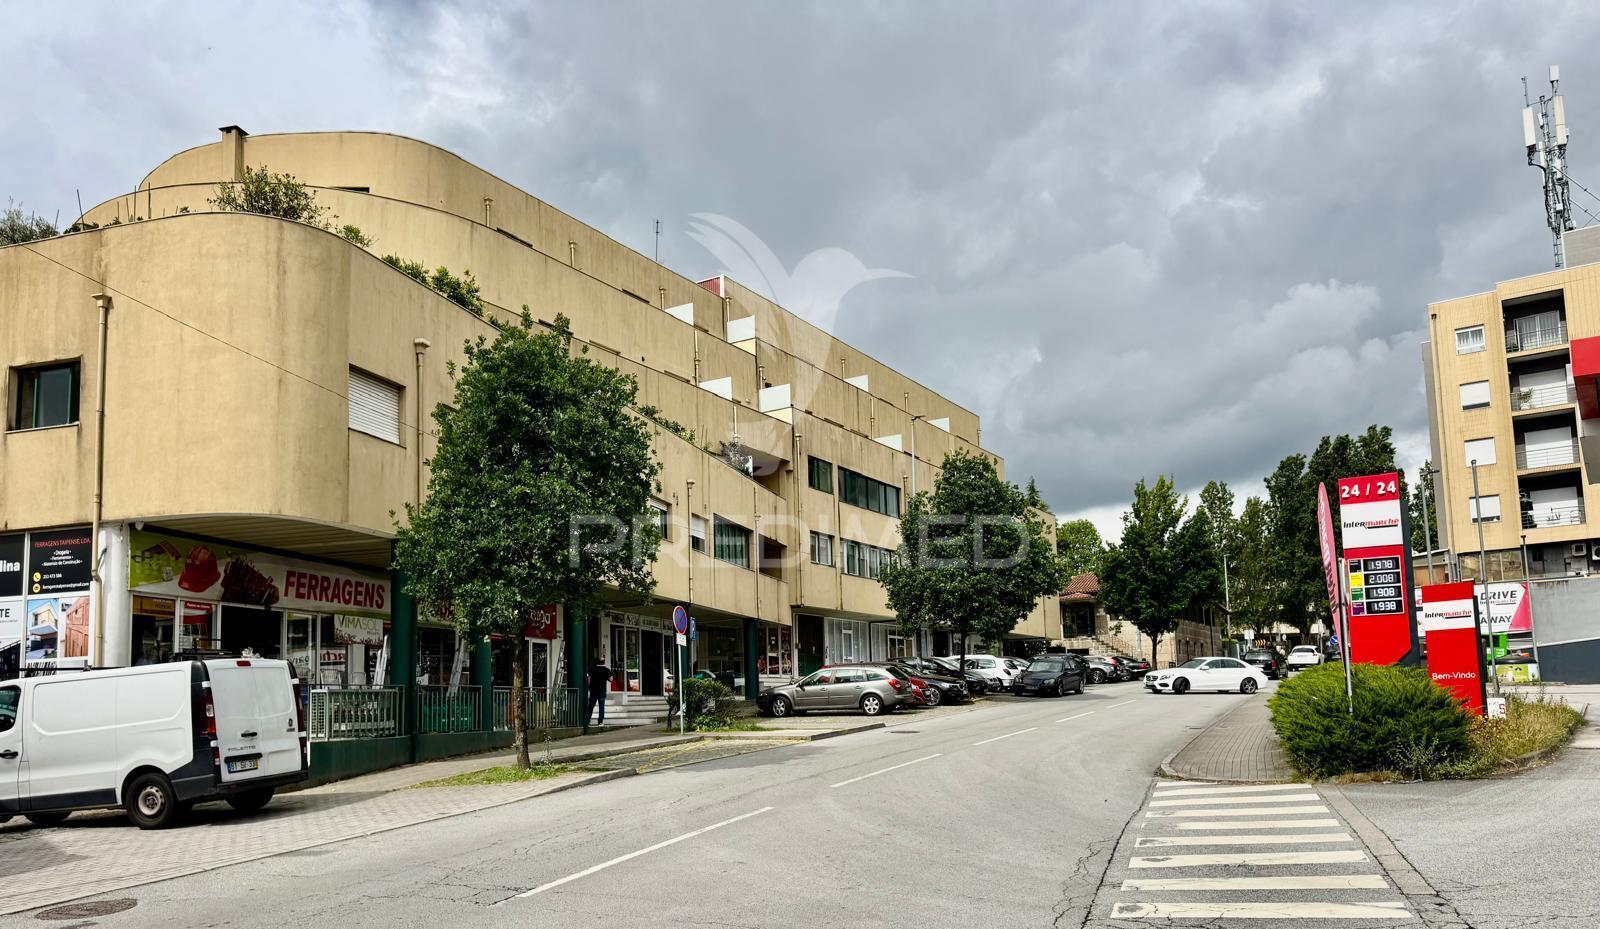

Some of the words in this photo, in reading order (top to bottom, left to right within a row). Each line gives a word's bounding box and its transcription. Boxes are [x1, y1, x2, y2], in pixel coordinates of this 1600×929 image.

[1341, 484, 1360, 498] 24
[1376, 480, 1397, 495] 24
[1371, 560, 1393, 569] 1.978
[283, 570, 386, 610] FERRAGENS
[1373, 587, 1395, 597] 1.908
[1481, 590, 1518, 600] DRIVE
[1374, 601, 1397, 611] 1.938
[338, 614, 381, 631] VIMASOL
[1480, 615, 1512, 625] AWAY
[1432, 671, 1476, 680] Bem-Vindo
